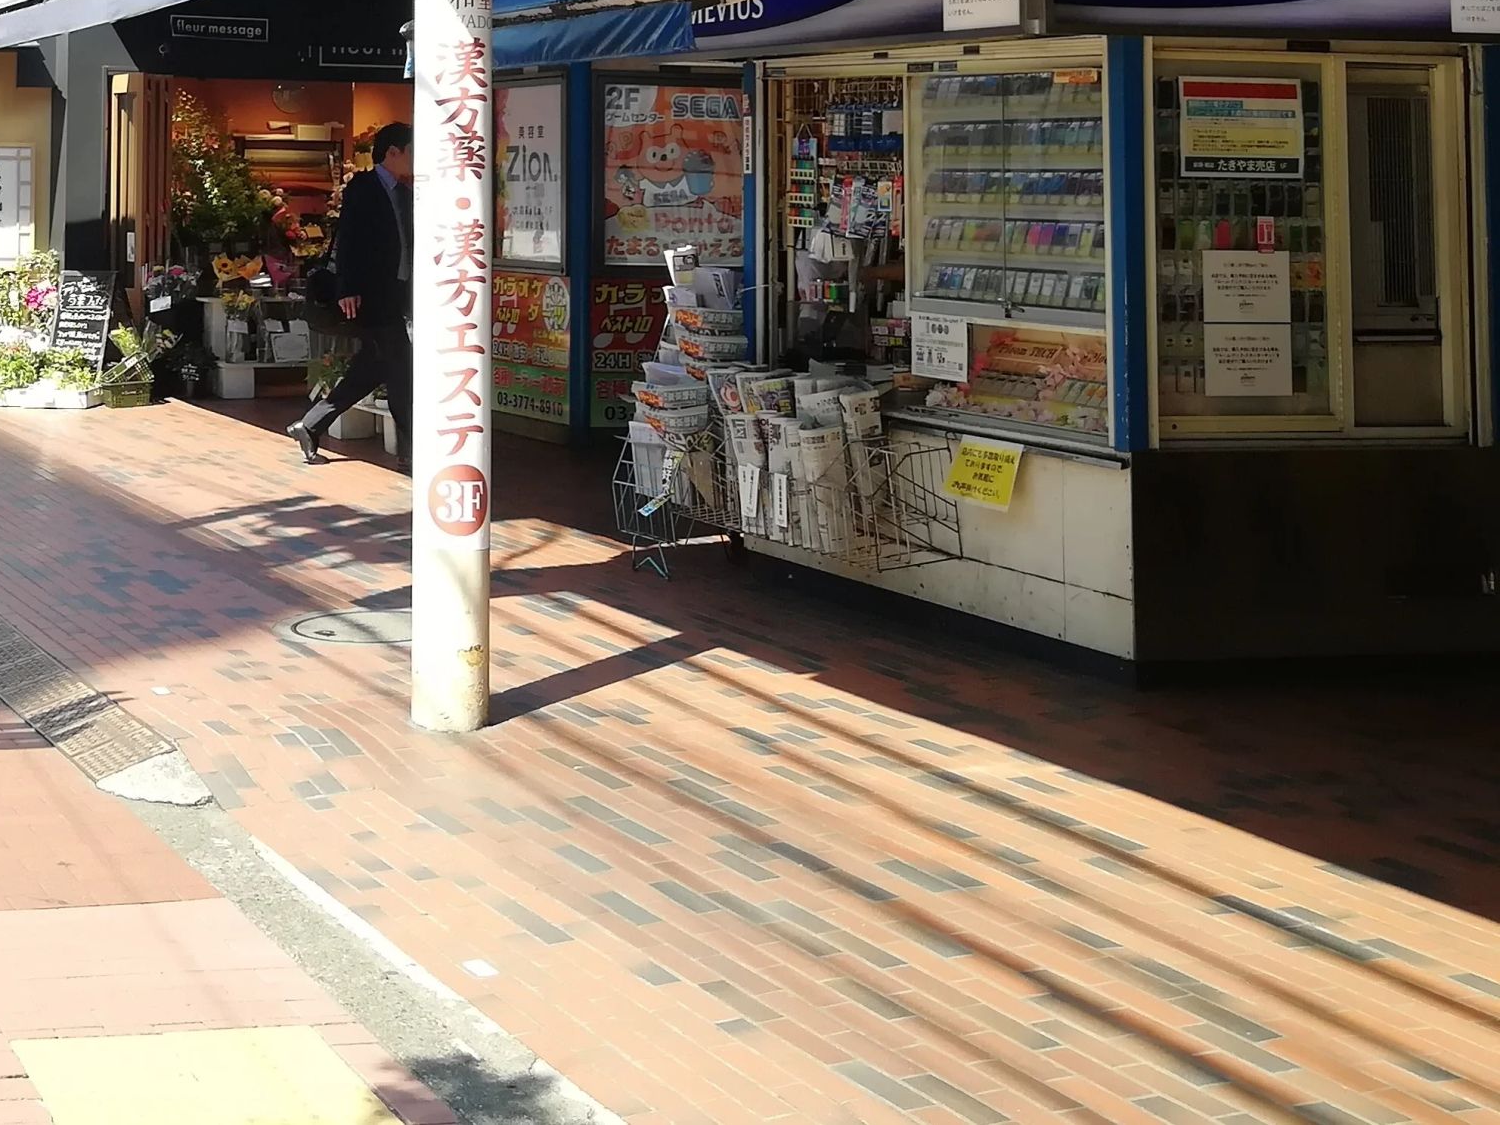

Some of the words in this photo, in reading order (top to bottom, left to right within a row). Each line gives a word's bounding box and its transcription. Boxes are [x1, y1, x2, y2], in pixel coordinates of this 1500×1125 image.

[176, 18, 205, 33] fleur
[208, 24, 263, 39] message
[605, 86, 641, 110] 2F
[671, 94, 741, 121] SEGA
[605, 112, 665, 124] ゲームセンター
[1218, 160, 1276, 172] たきやま売店
[434, 38, 488, 456] 漢方薬・漢方エステ
[600, 315, 654, 333] ベスト10
[595, 355, 632, 370] 24H
[497, 390, 564, 417] 03-3774-8910
[436, 480, 484, 525] 3F
